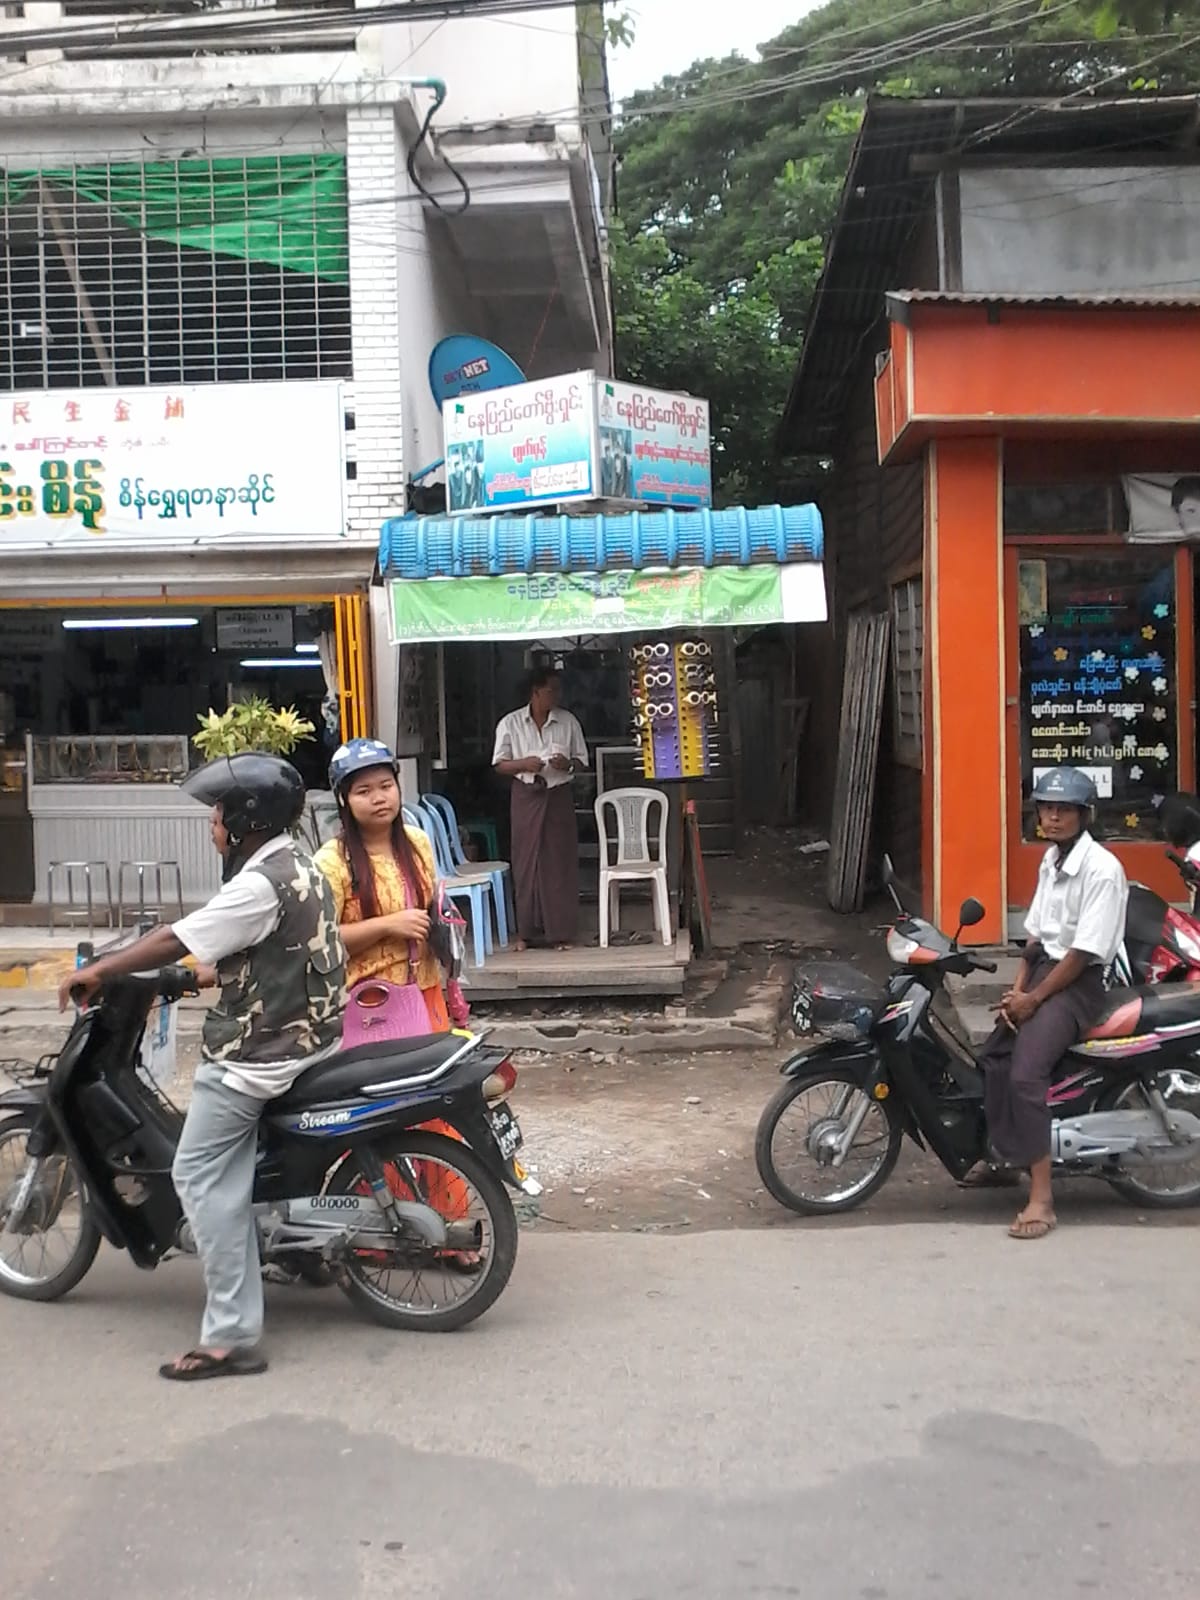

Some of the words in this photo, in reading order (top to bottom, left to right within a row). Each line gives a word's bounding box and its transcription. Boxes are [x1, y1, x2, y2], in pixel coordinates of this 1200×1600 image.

[119, 473, 276, 519] စိန်ရွှေရတနာဆိုင်
[299, 1112, 351, 1129] Stream
